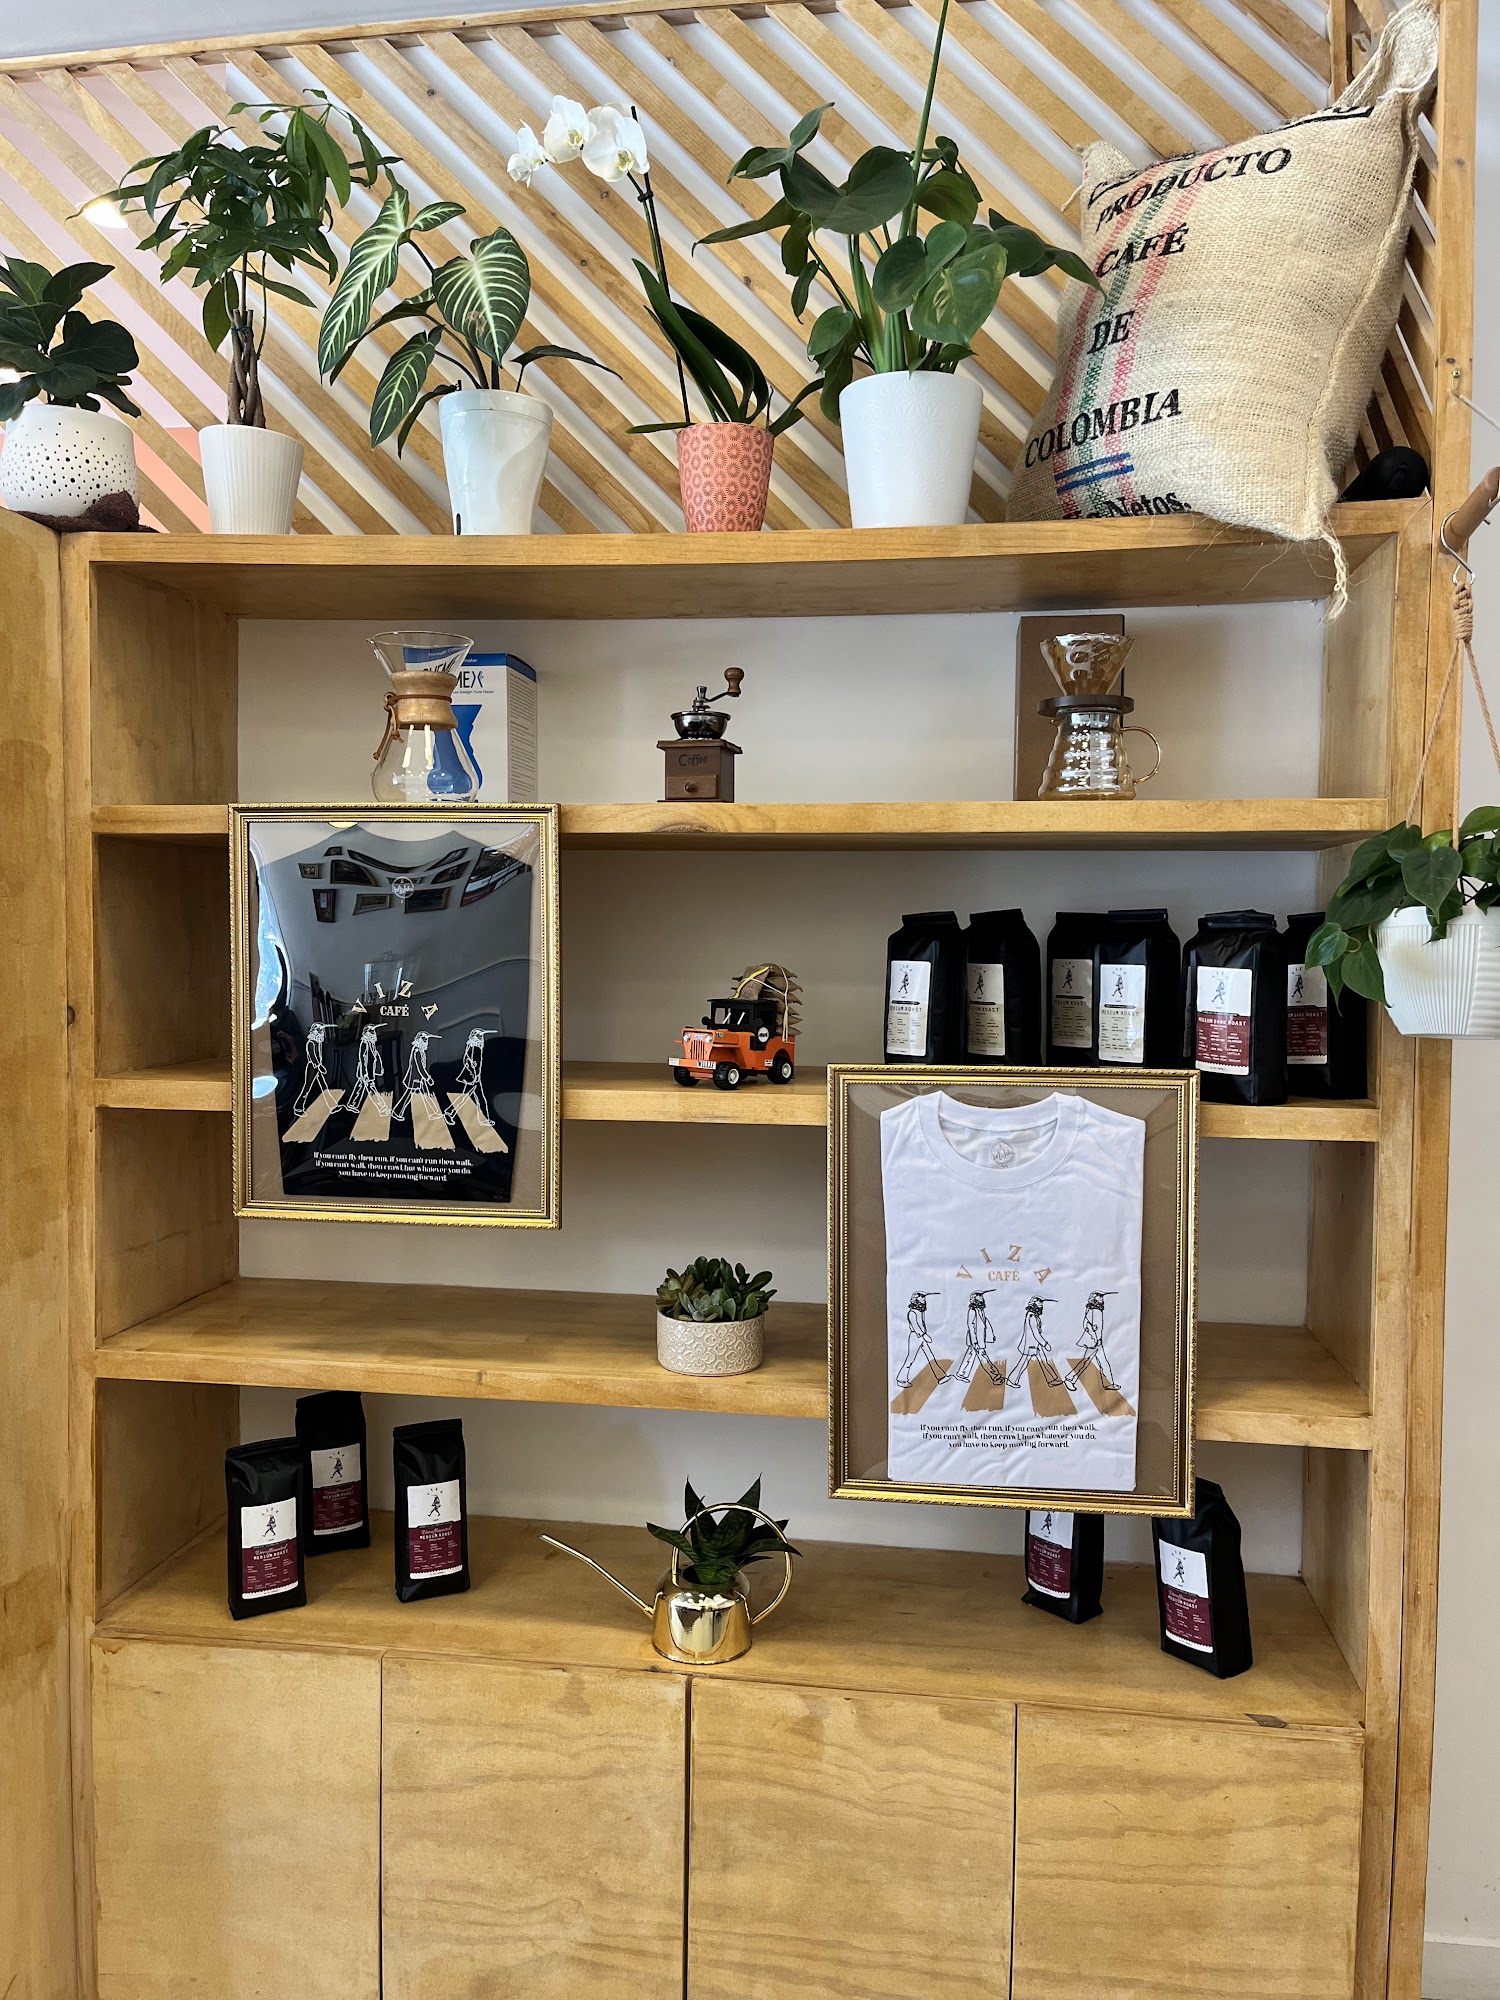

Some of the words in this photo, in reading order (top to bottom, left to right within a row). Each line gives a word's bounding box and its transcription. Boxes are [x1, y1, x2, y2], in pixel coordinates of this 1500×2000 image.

[1094, 147, 1292, 233] PRODUCTO
[1095, 223, 1189, 278] CAFÉ
[1087, 310, 1135, 355] DE
[1024, 388, 1182, 469] COLOMBIA
[380, 1004, 410, 1017] CAFÉ
[376, 1171, 392, 1180] keep
[393, 1173, 418, 1181] moving
[988, 1268, 1020, 1281] CAFÉ
[990, 1441, 1007, 1449] keep
[1009, 1440, 1036, 1448] moving
